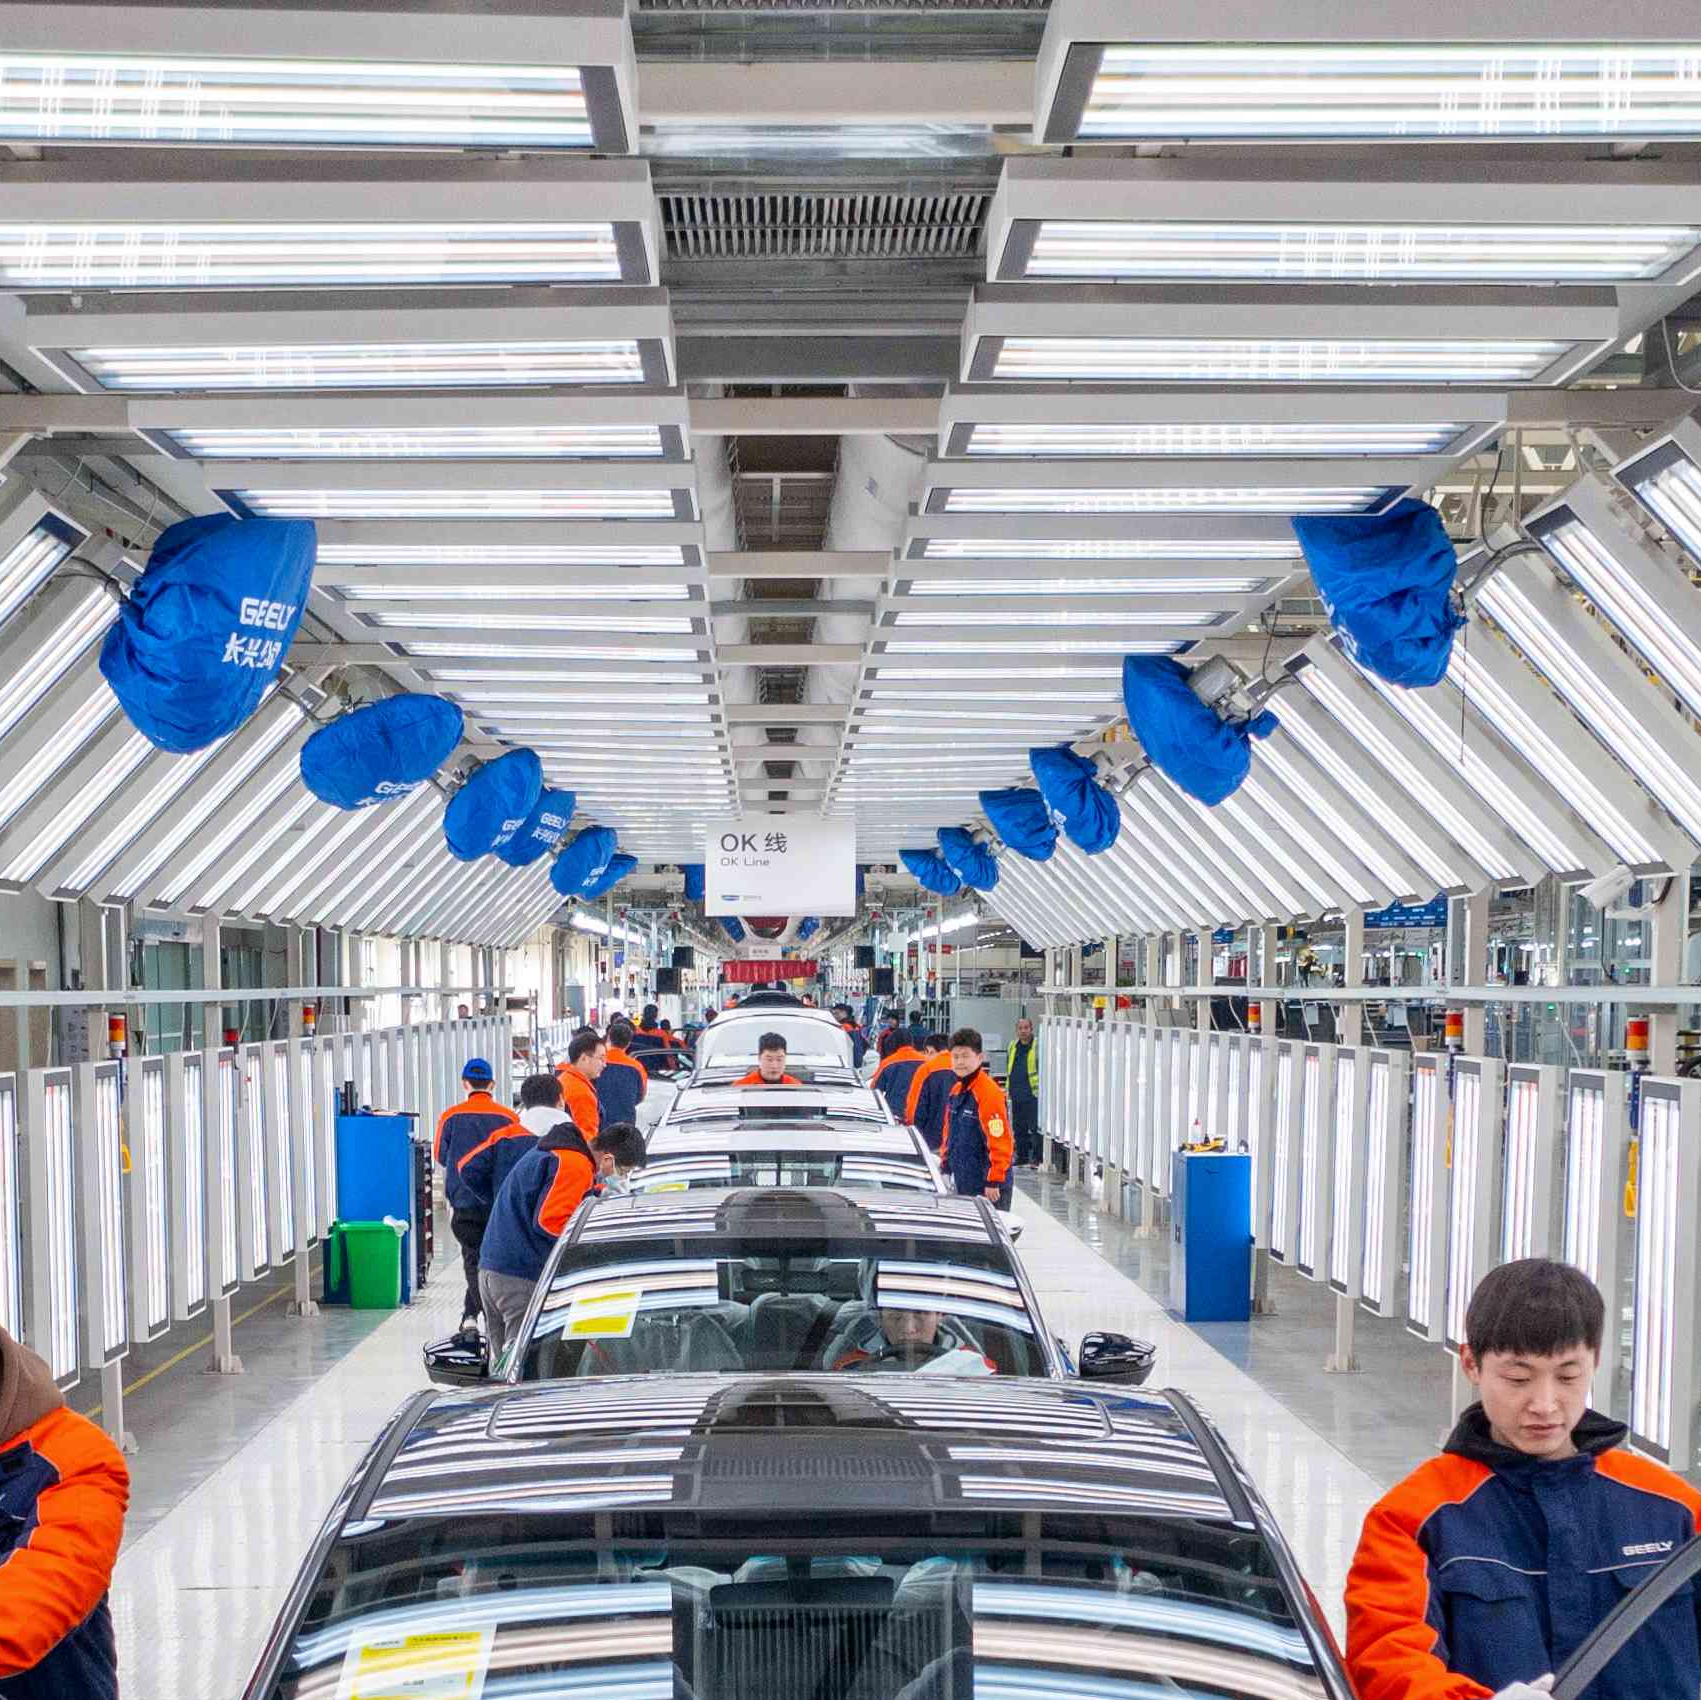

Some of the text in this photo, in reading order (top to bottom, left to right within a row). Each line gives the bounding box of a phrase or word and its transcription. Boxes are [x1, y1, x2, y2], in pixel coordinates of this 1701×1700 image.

[238, 596, 298, 632] GEELY
[720, 831, 788, 854] OK 线
[720, 856, 770, 867] OK Line
